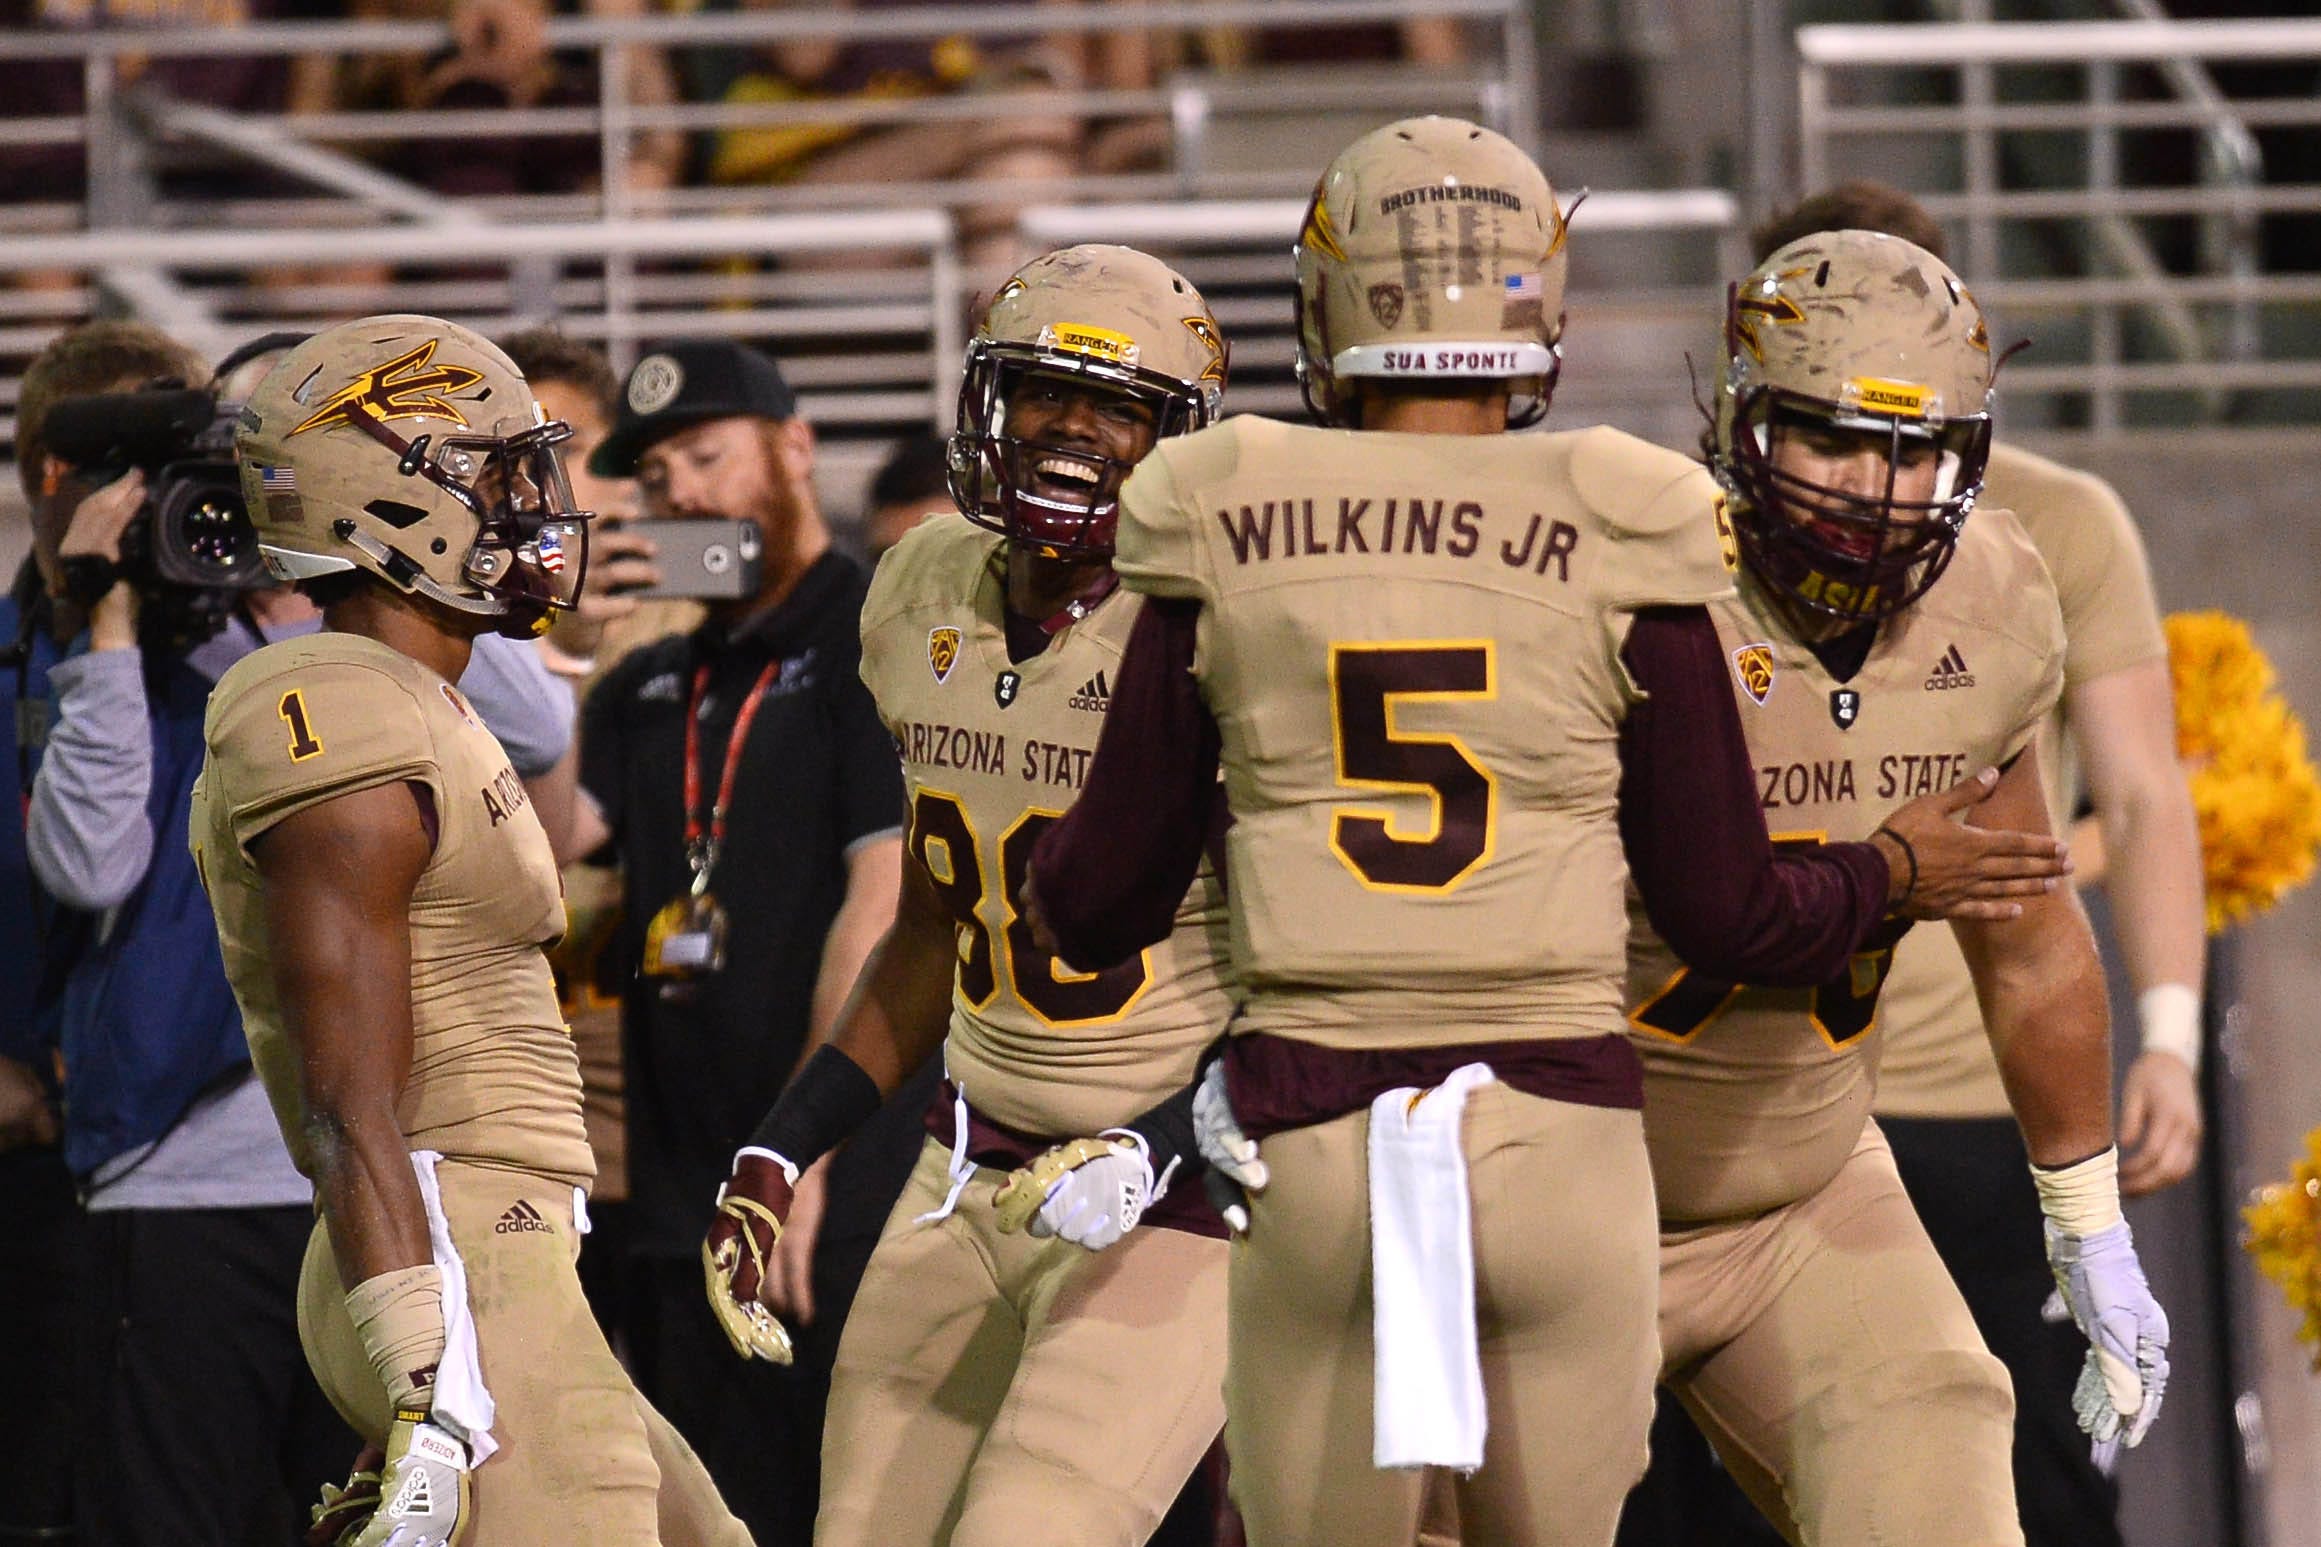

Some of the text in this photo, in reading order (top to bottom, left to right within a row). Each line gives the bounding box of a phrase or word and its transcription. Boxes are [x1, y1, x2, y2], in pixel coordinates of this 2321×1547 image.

[1380, 185, 1521, 216] BROTHERHOOD
[1063, 332, 1119, 355] RANGER
[1384, 351, 1517, 370] SUA SPONTE
[1862, 388, 1919, 408] RANGER
[1217, 497, 1579, 582] WILKINS JR
[1924, 672, 1975, 691] adidas
[1068, 696, 1109, 713] adida
[278, 687, 325, 764] 1
[1022, 739, 1092, 789] STAT
[1327, 638, 1497, 896] 5
[1762, 758, 1857, 808] ZONA
[494, 1216, 554, 1235] adidas
